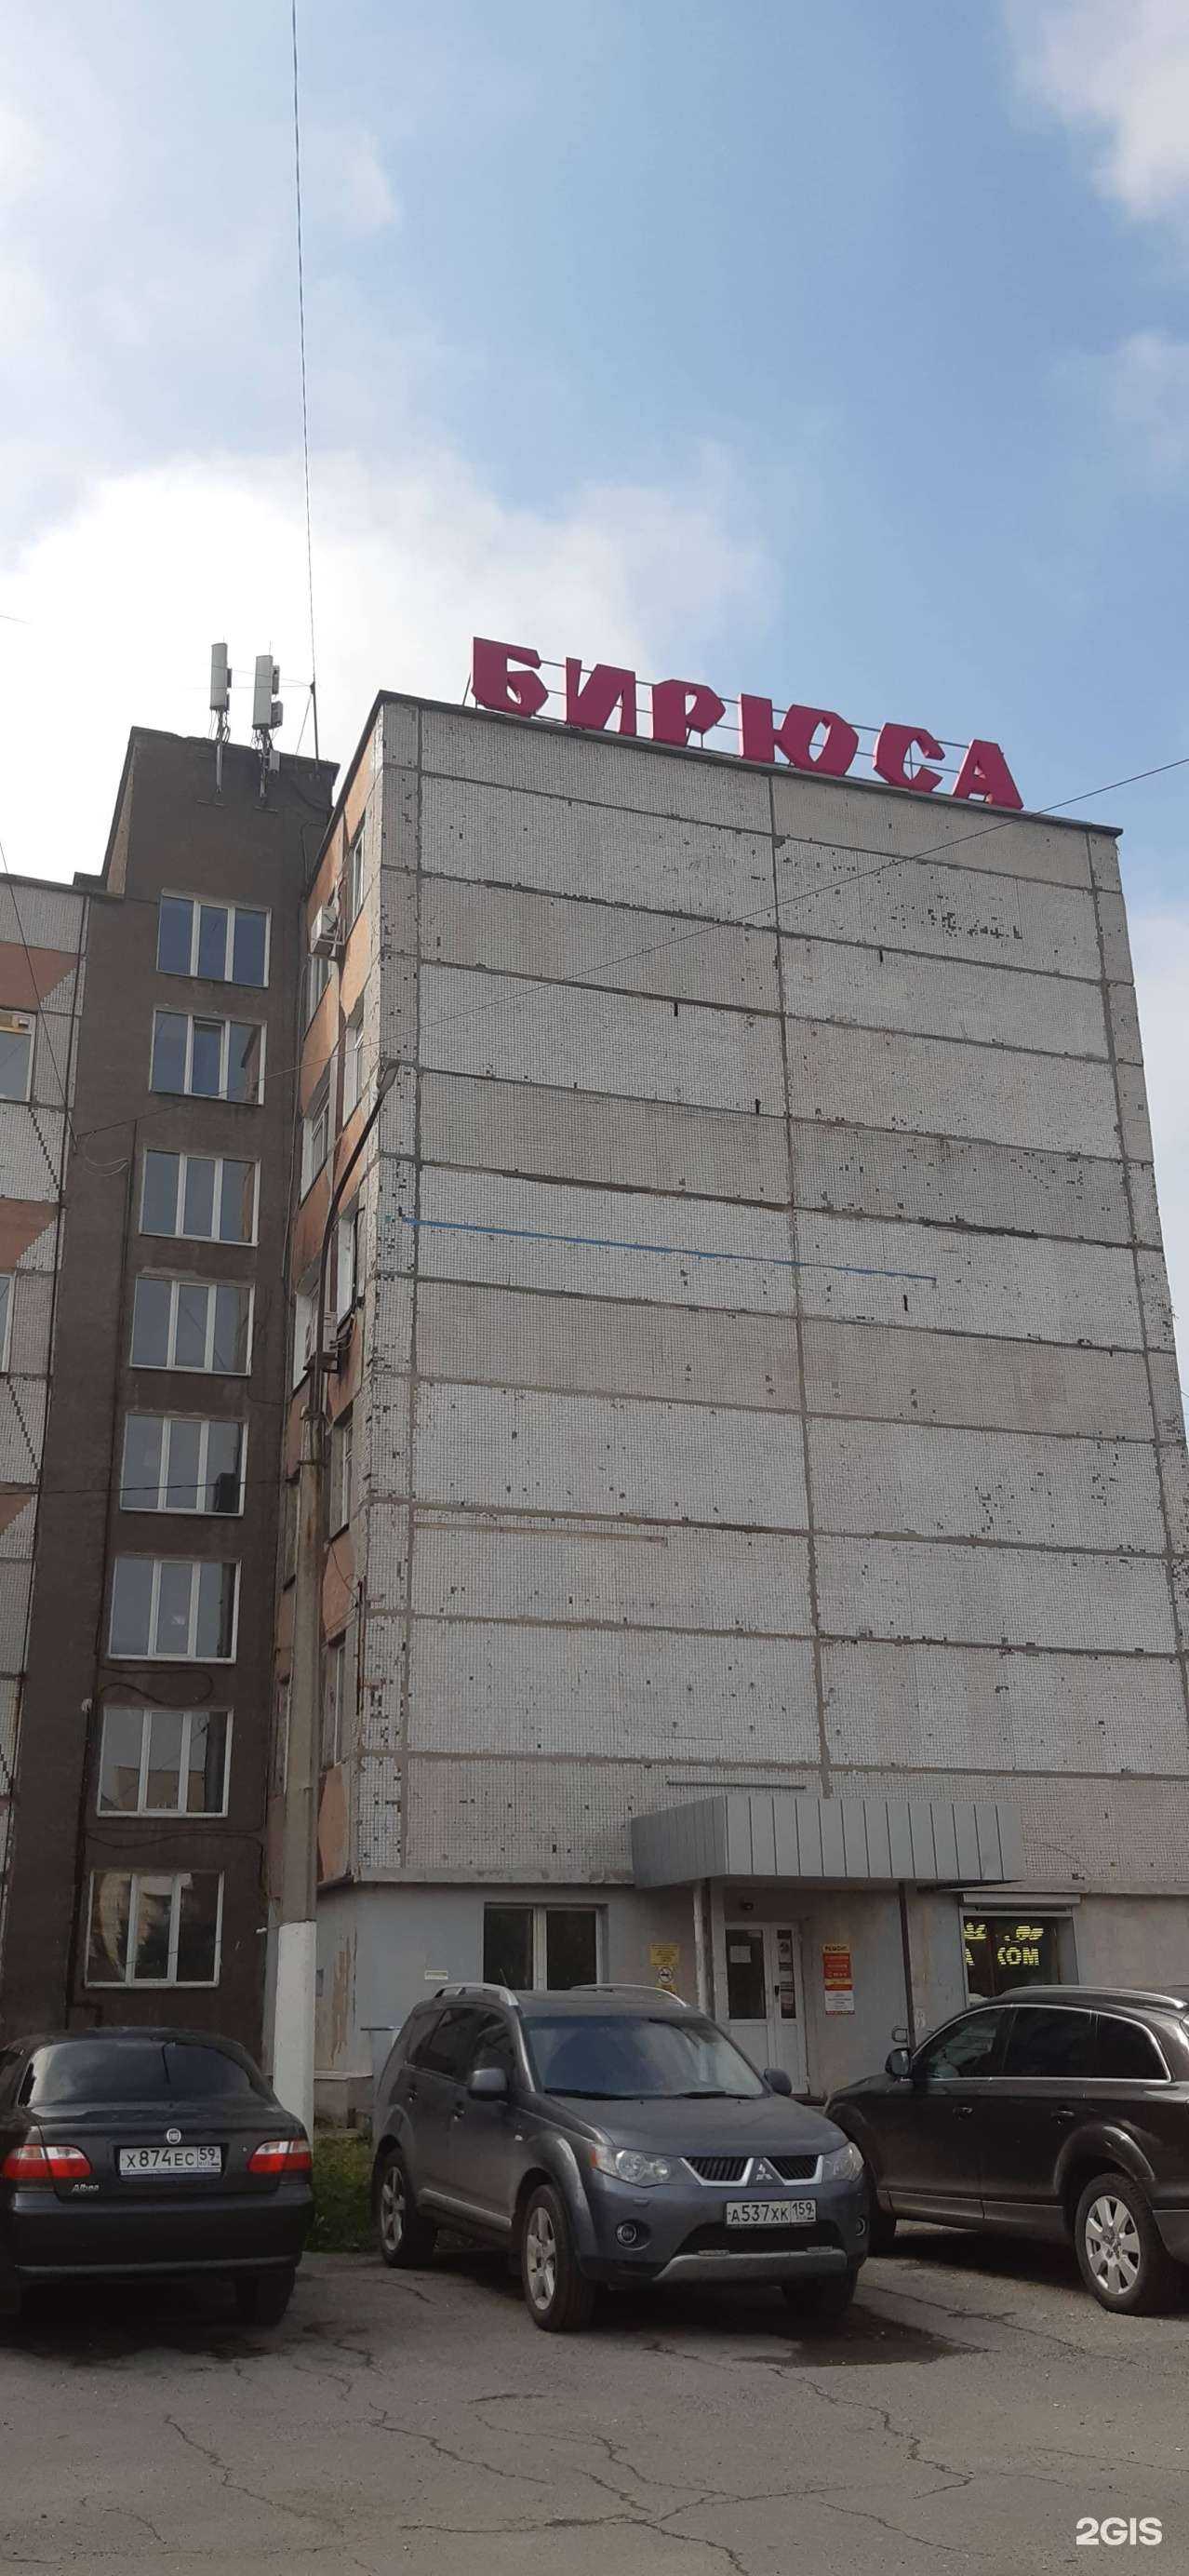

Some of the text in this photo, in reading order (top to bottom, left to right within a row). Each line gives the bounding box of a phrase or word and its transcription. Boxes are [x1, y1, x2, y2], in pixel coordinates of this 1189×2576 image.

[471, 637, 1023, 810] БИРЮСА
[199, 2147, 216, 2161] 59
[792, 2202, 812, 2215] 159
